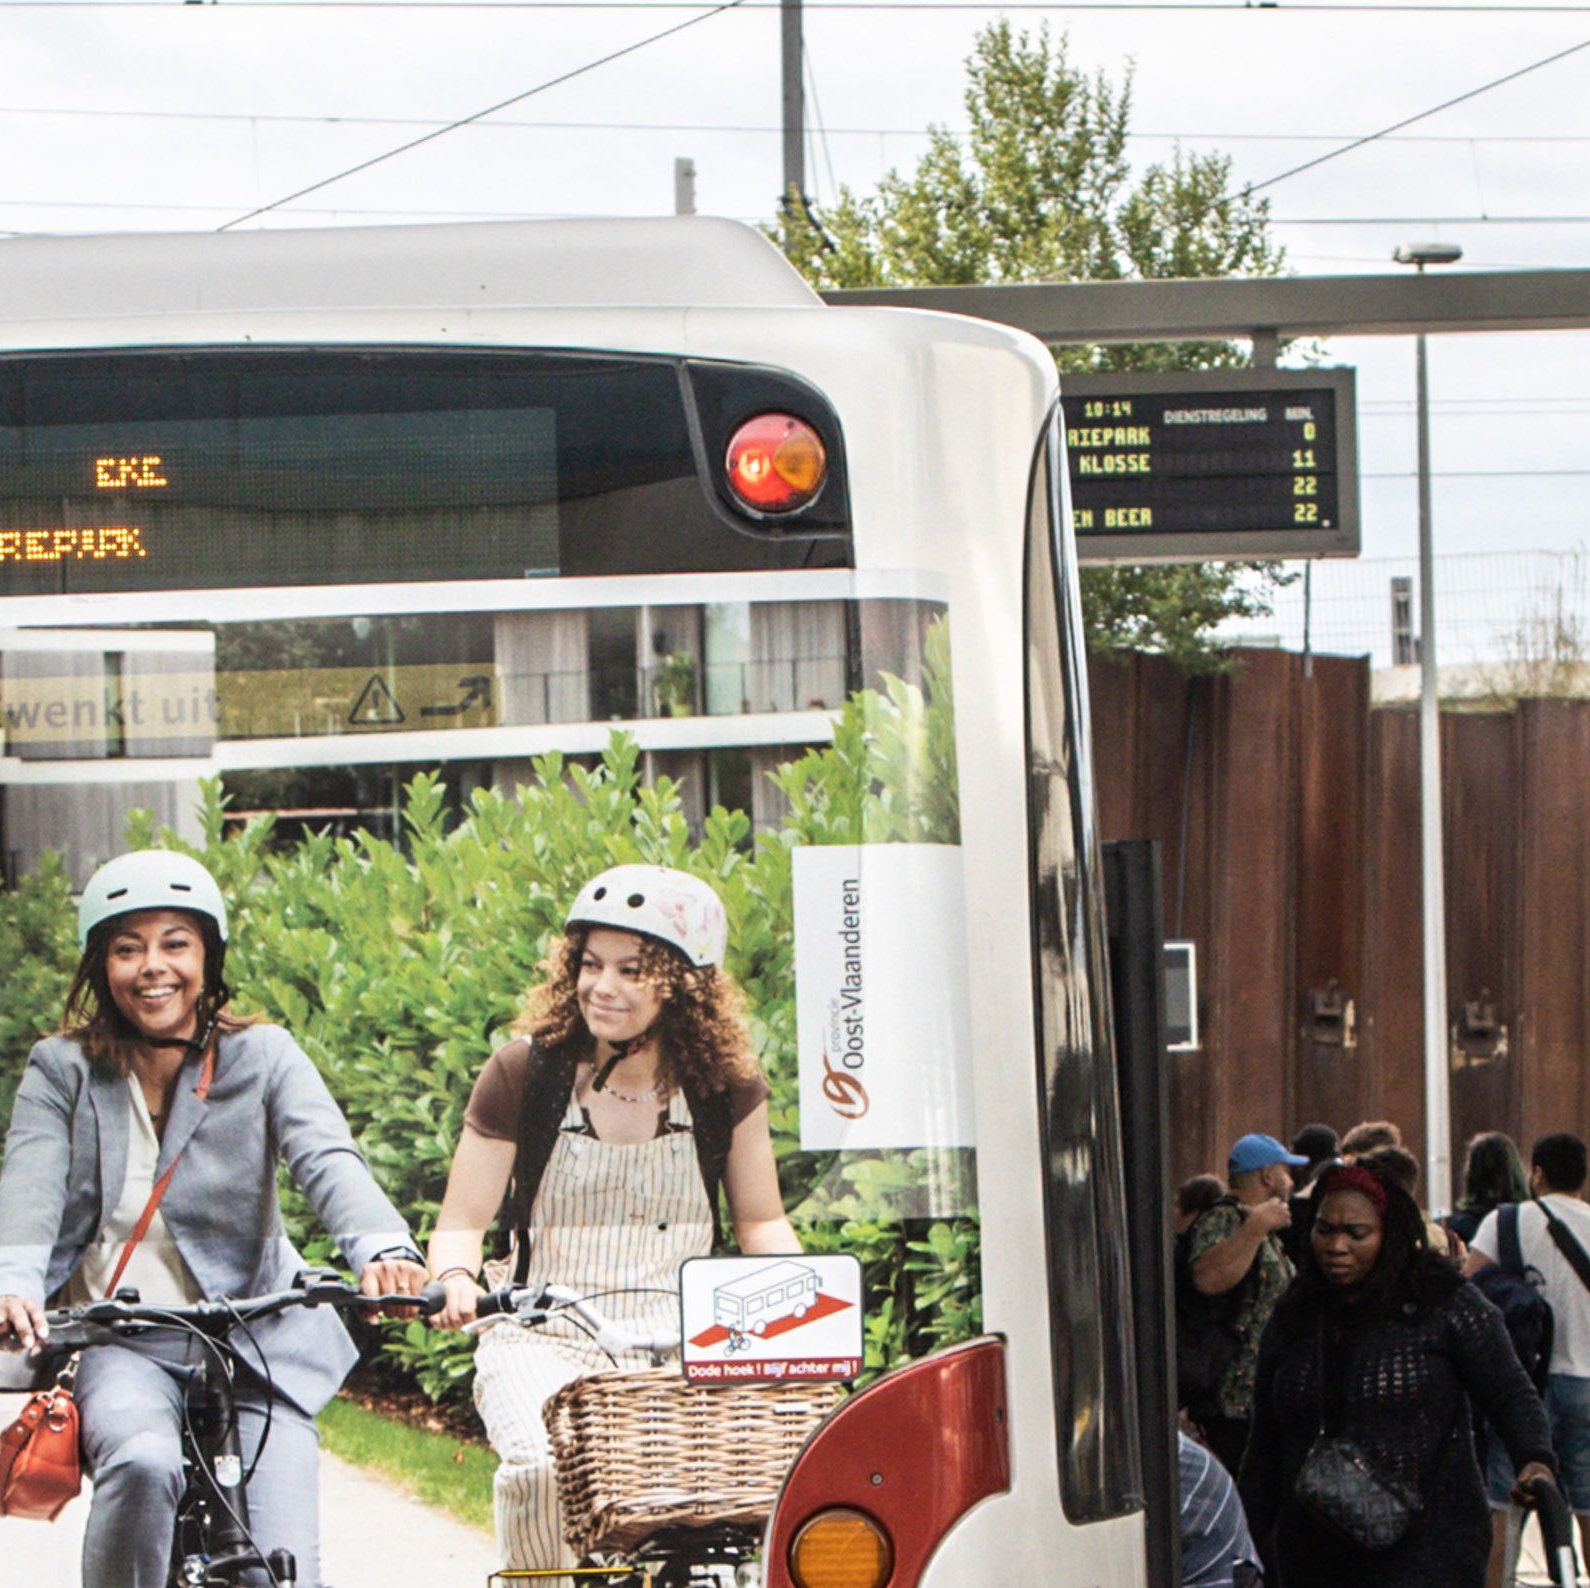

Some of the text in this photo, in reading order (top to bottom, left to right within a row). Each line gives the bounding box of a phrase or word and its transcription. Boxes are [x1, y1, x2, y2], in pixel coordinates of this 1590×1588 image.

[1163, 407, 1267, 424] DIENSTREGELING
[96, 456, 168, 488] EKE
[1080, 449, 1317, 474] KLOSSE 11
[1293, 475, 1317, 496] 22
[1105, 507, 1152, 528] BEER
[1294, 503, 1318, 522] 22
[163, 686, 221, 725] uit
[838, 877, 865, 1070] Oost-Vlaanderen
[688, 1365, 722, 1378] Dode
[724, 1363, 755, 1376] hoek
[763, 1361, 787, 1378] Blijf
[789, 1361, 829, 1375] achter
[832, 1360, 852, 1377] mij
